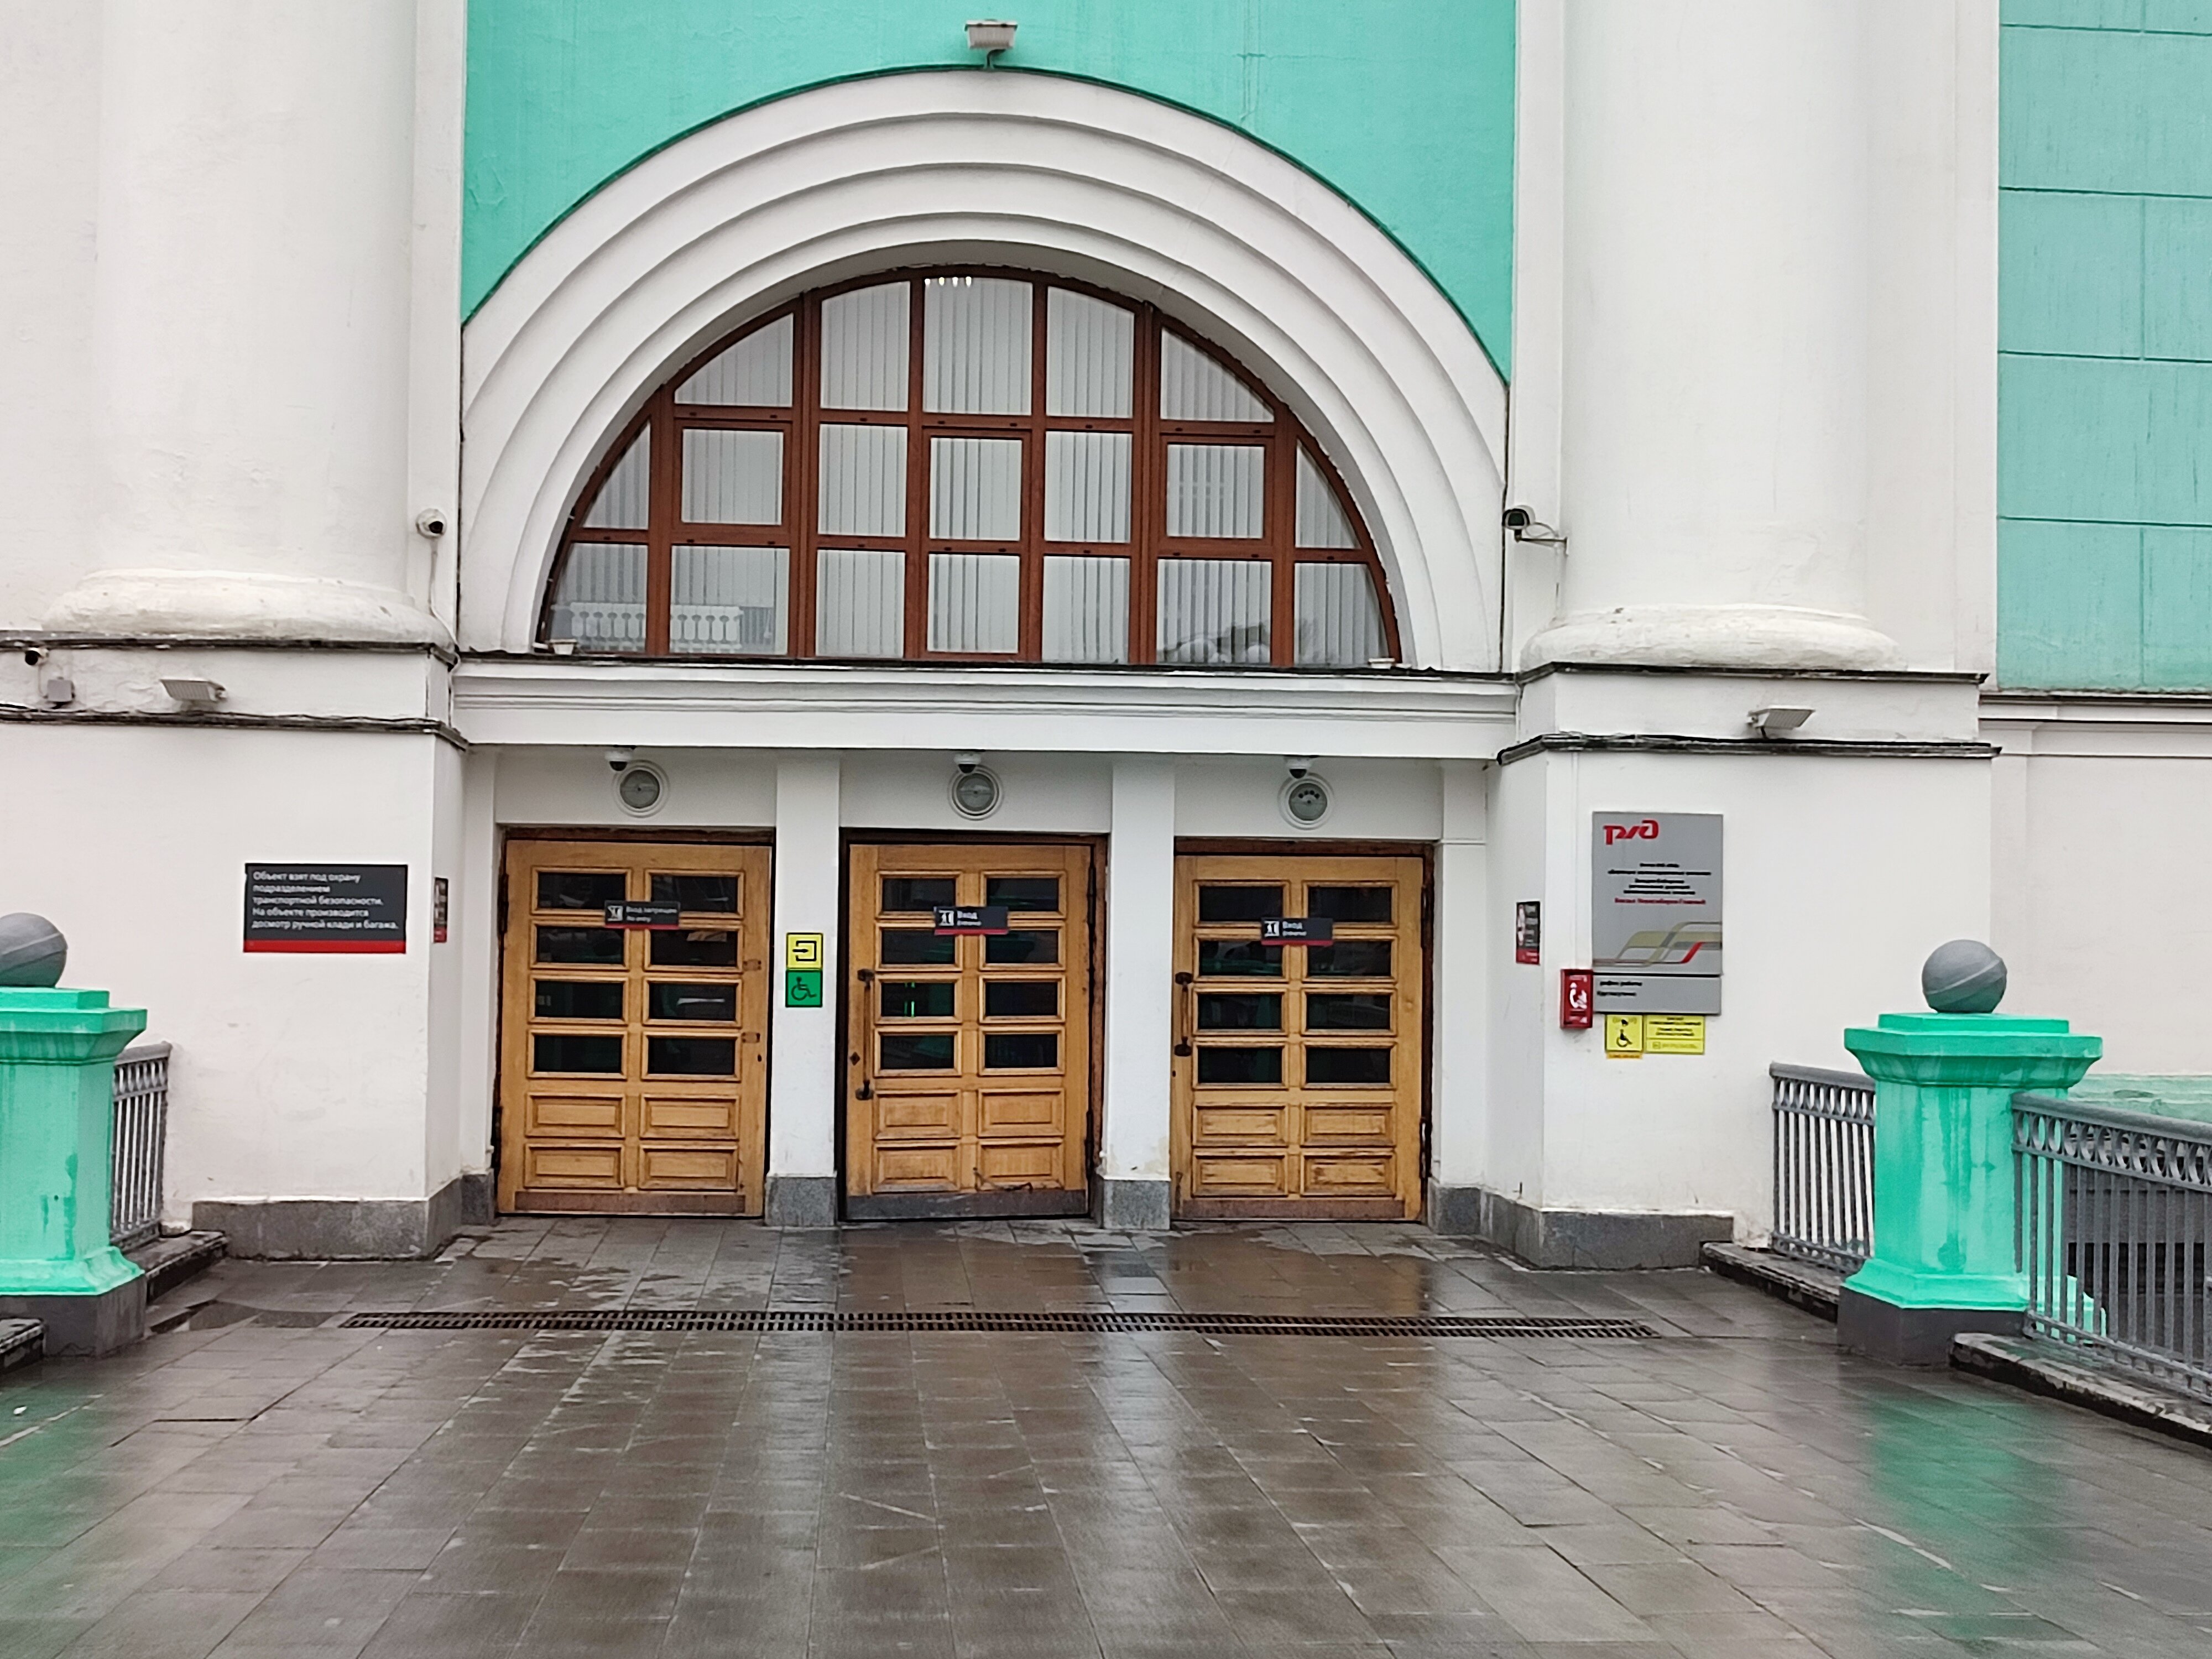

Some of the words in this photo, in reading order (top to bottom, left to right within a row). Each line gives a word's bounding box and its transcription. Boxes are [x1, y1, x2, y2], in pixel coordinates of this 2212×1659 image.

[253, 870, 287, 880] Объект
[309, 874, 327, 882] под
[328, 874, 361, 883] охрану
[253, 885, 330, 893] подразделением
[252, 895, 317, 905] транспортной
[319, 895, 384, 905] безопасности.
[252, 907, 265, 916] На
[267, 906, 304, 916] объекте
[252, 920, 290, 930] досмотр
[292, 919, 326, 930] ручной
[363, 919, 399, 929] багажа.
